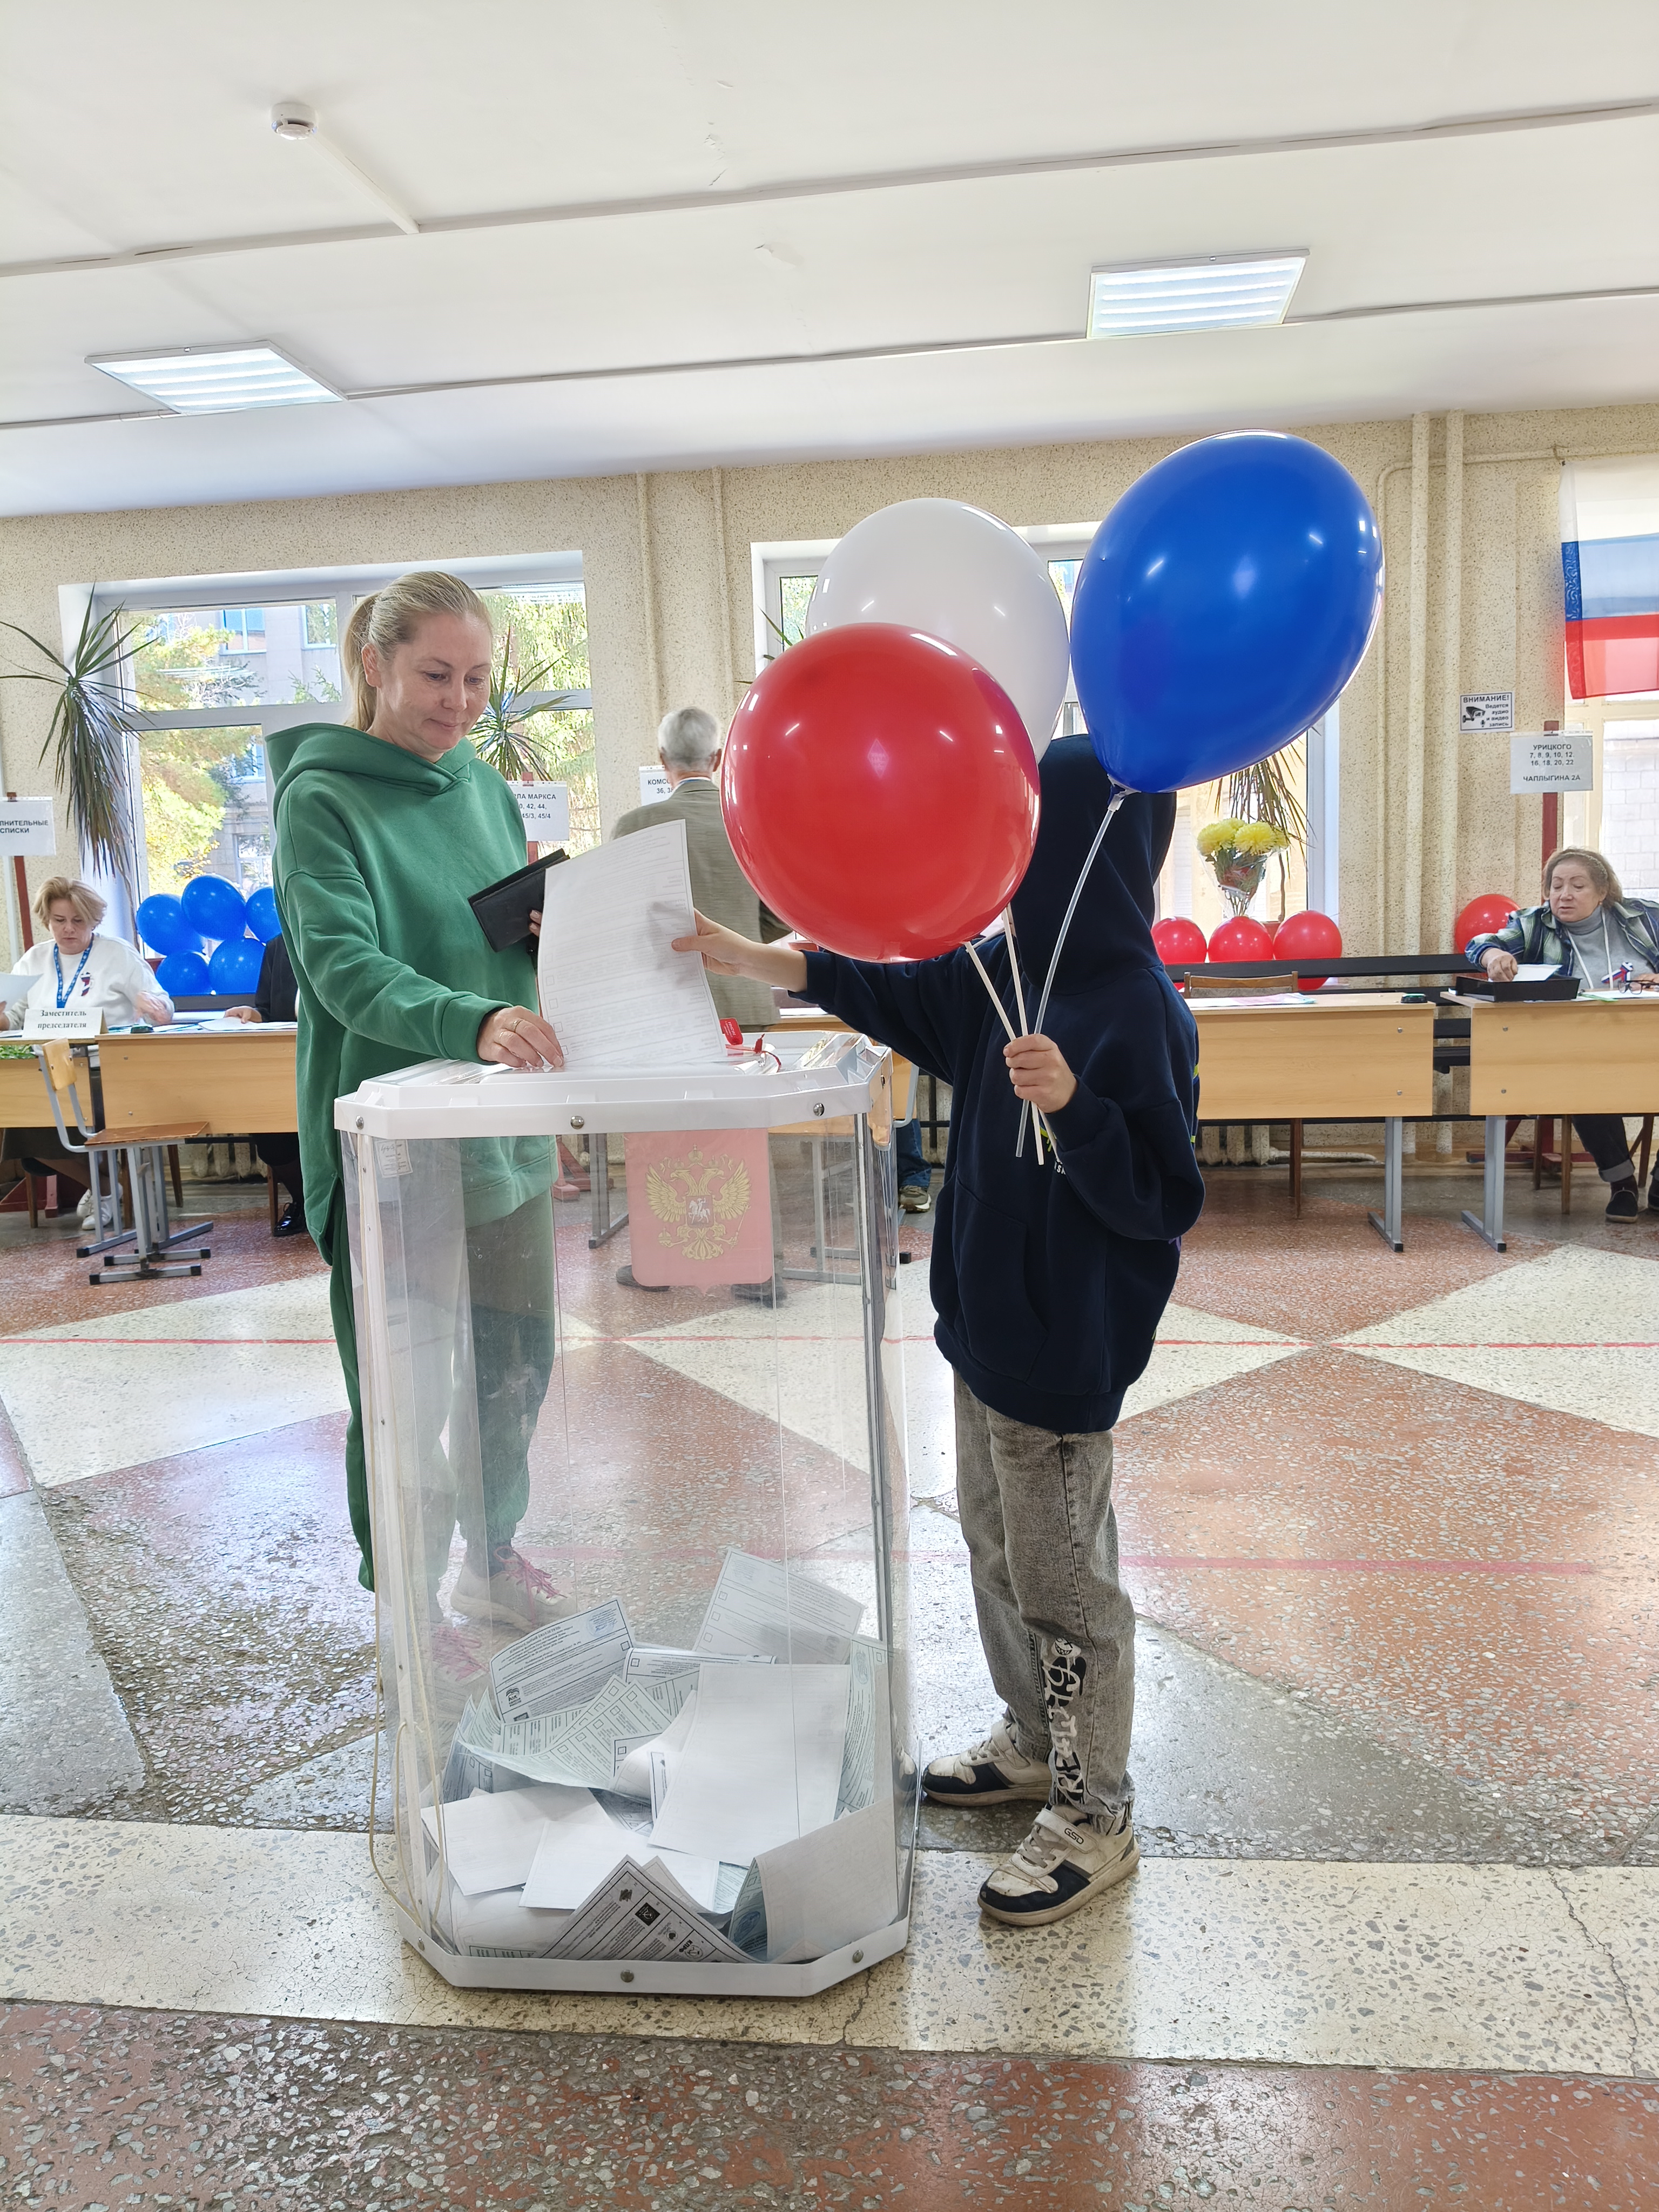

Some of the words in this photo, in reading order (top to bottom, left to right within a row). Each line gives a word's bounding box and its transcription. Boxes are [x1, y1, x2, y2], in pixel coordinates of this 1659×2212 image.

[1463, 694, 1509, 703] ВНИМАНИЕ!
[37, 1022, 87, 1030] председателя
[1064, 1827, 1084, 1845] GSD
[679, 1939, 693, 1953] КПРФ
